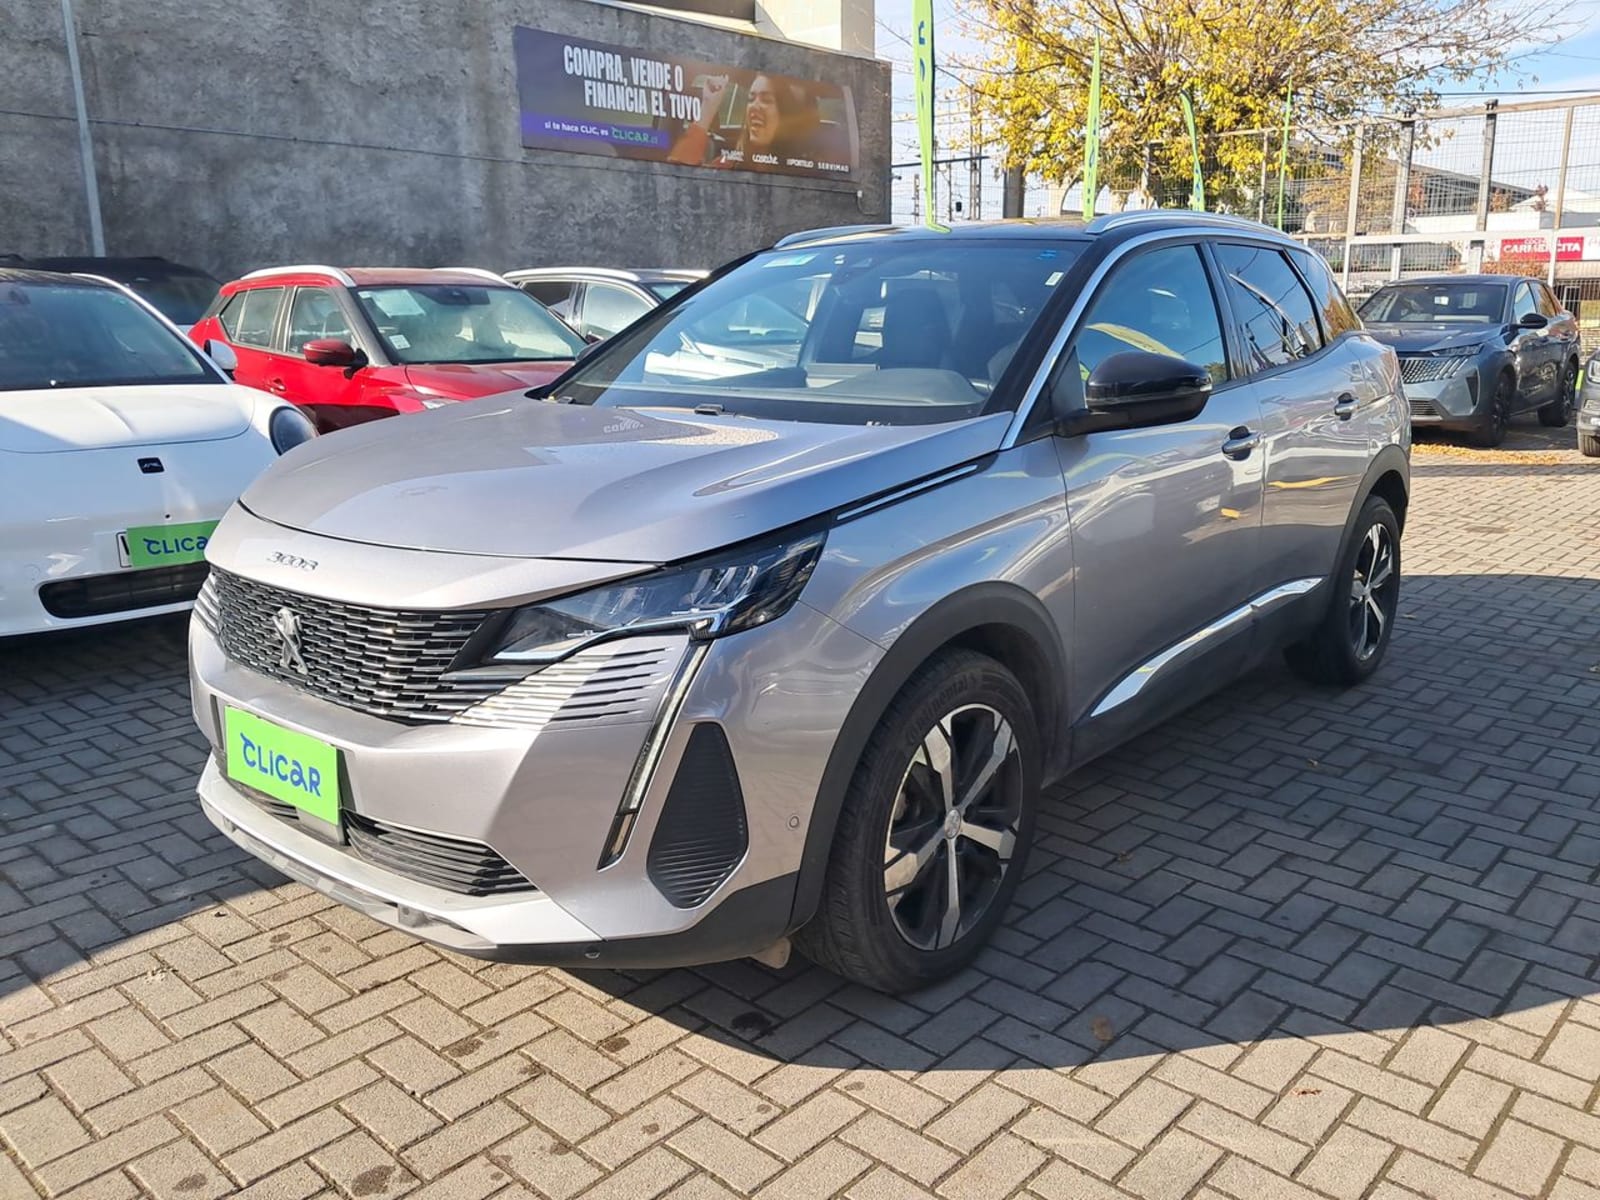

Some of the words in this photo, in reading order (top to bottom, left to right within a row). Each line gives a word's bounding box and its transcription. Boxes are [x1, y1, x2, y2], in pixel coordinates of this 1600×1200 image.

[563, 45, 629, 87] COMPRA,
[630, 57, 673, 90] VENDE
[673, 65, 684, 91] O
[584, 79, 648, 116] FINANCIA
[650, 91, 667, 117] EL
[668, 93, 701, 122] TUYO
[266, 551, 320, 571] 3008
